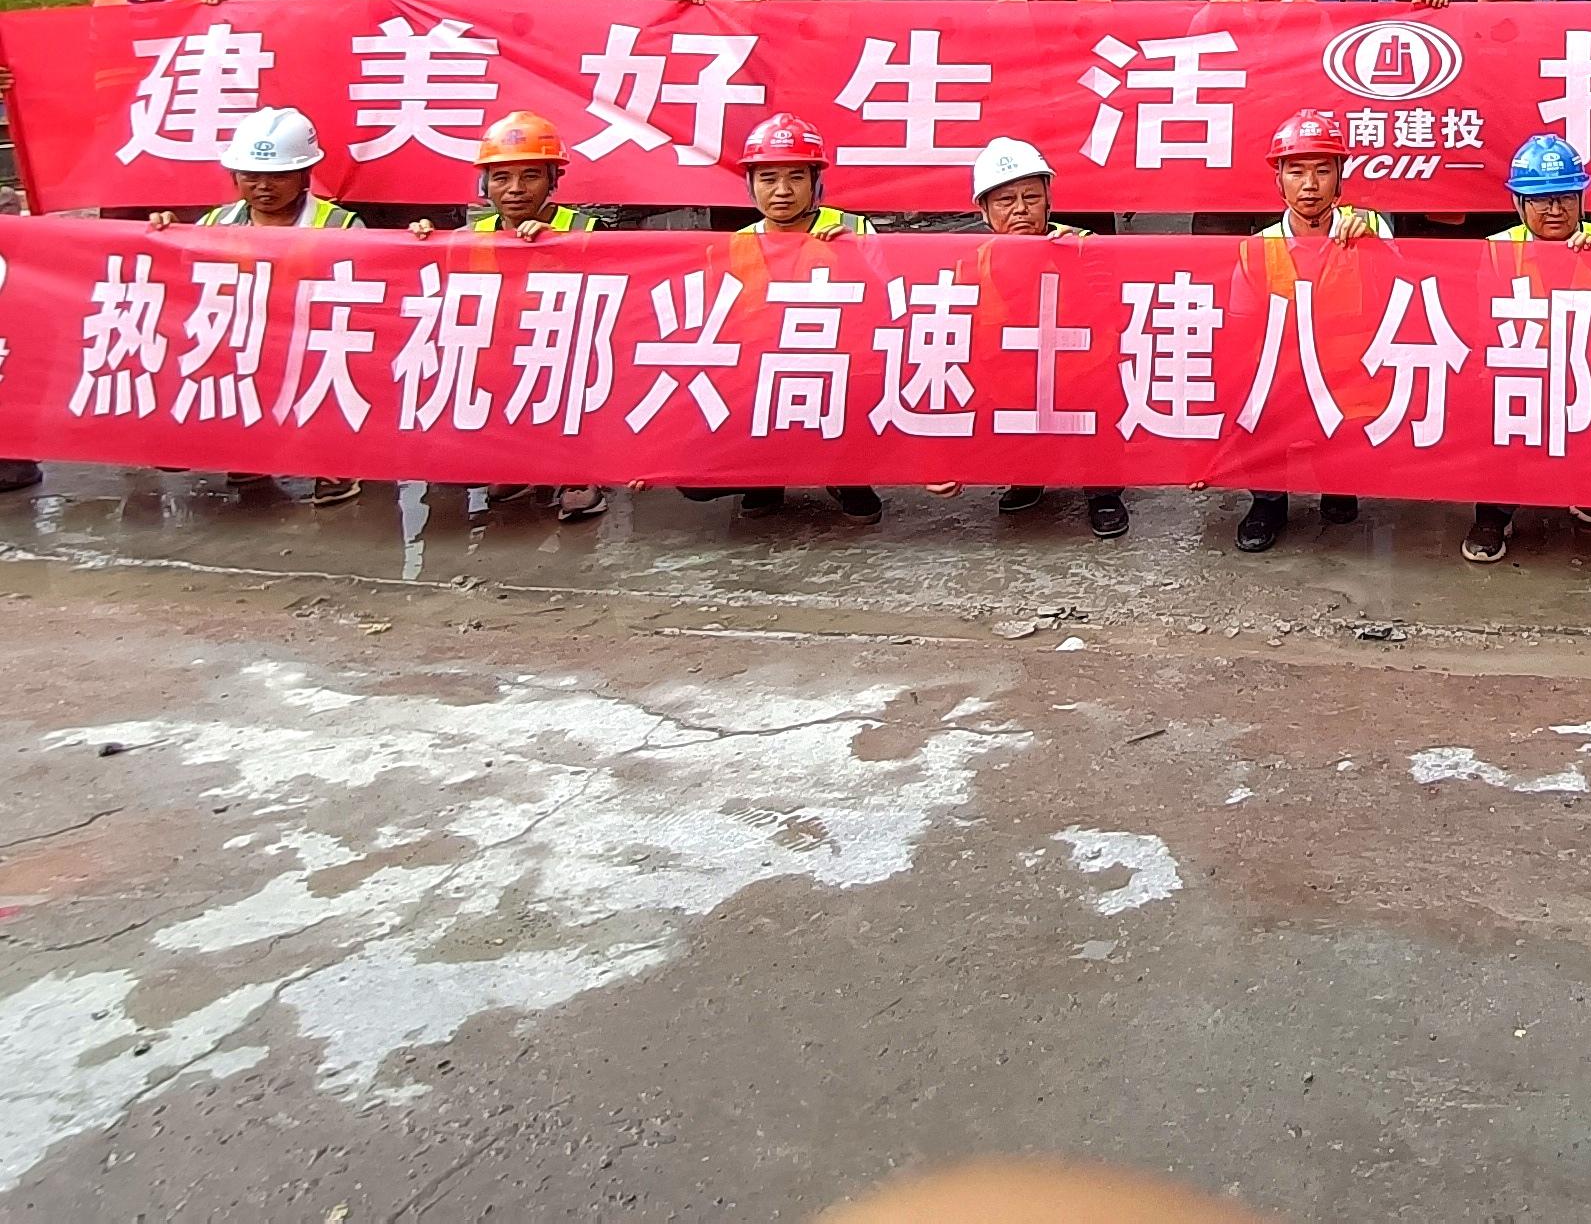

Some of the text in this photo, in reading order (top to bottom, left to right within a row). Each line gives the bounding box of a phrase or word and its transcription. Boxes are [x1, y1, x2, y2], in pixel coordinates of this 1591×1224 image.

[116, 17, 1249, 170] 建美好生活
[1316, 107, 1484, 148] 南建投
